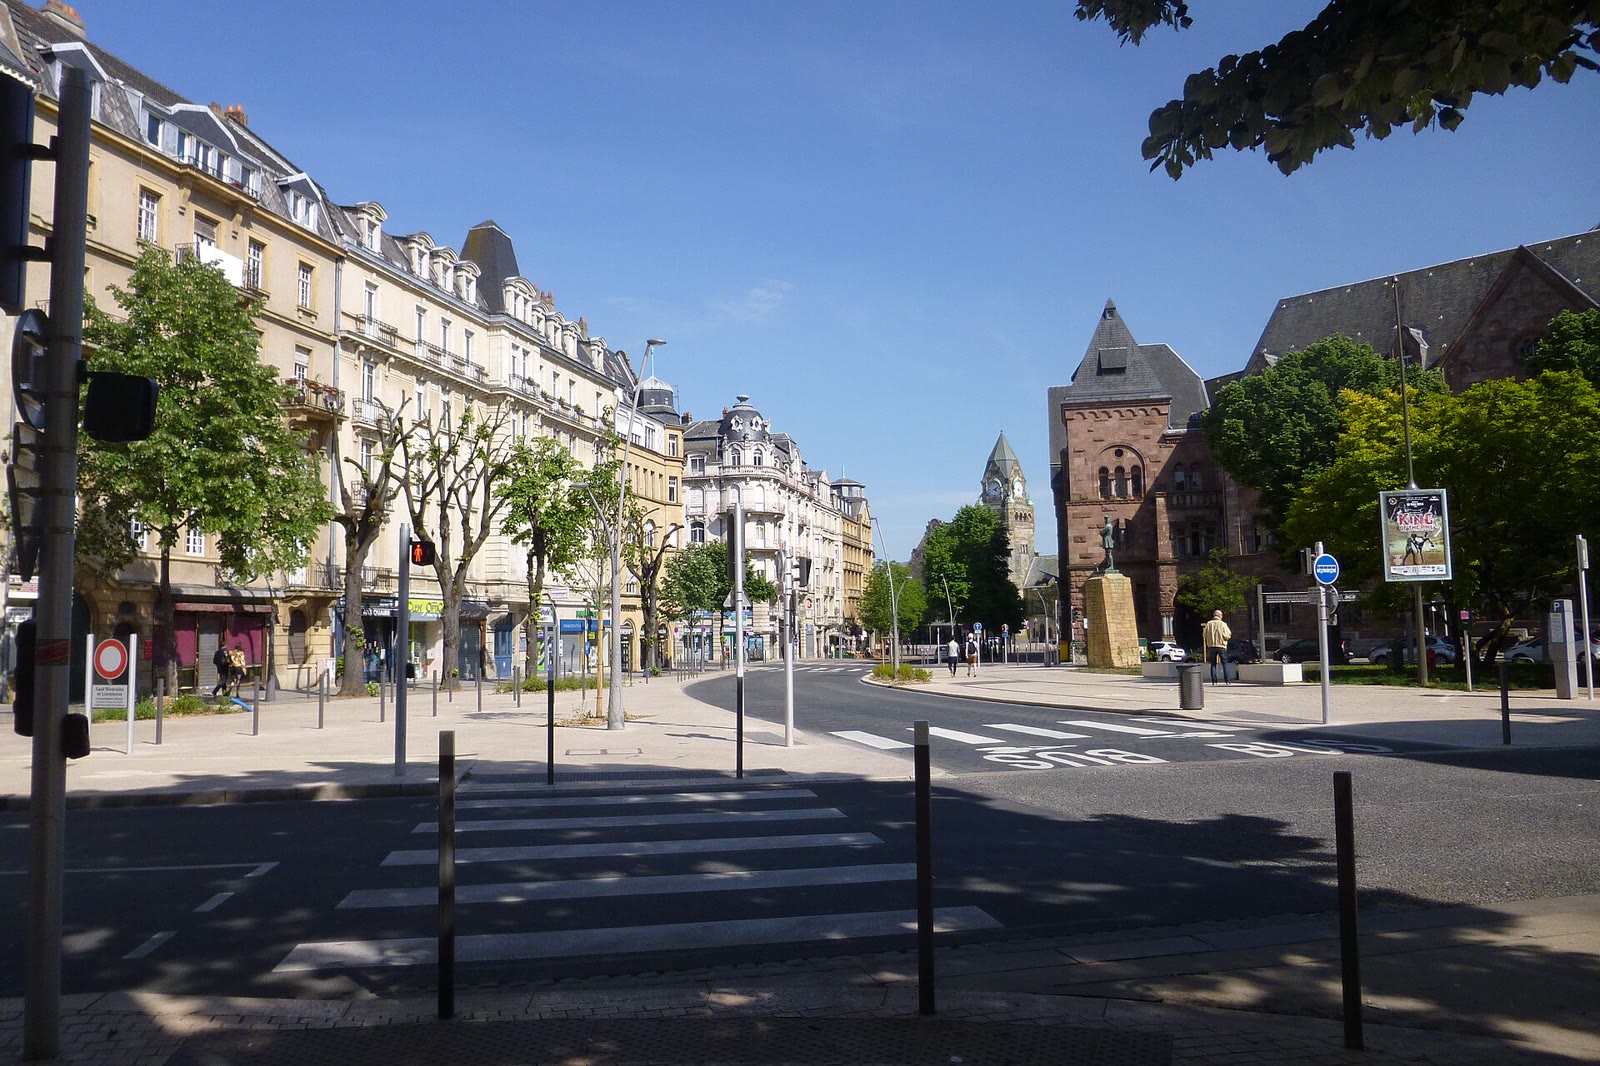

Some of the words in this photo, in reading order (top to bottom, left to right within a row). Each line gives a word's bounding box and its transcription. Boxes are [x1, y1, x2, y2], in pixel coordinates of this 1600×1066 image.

[1399, 513, 1433, 525] KING
[1553, 602, 1560, 611] P
[1204, 740, 1394, 759] BUS
[983, 748, 1170, 769] BUS
